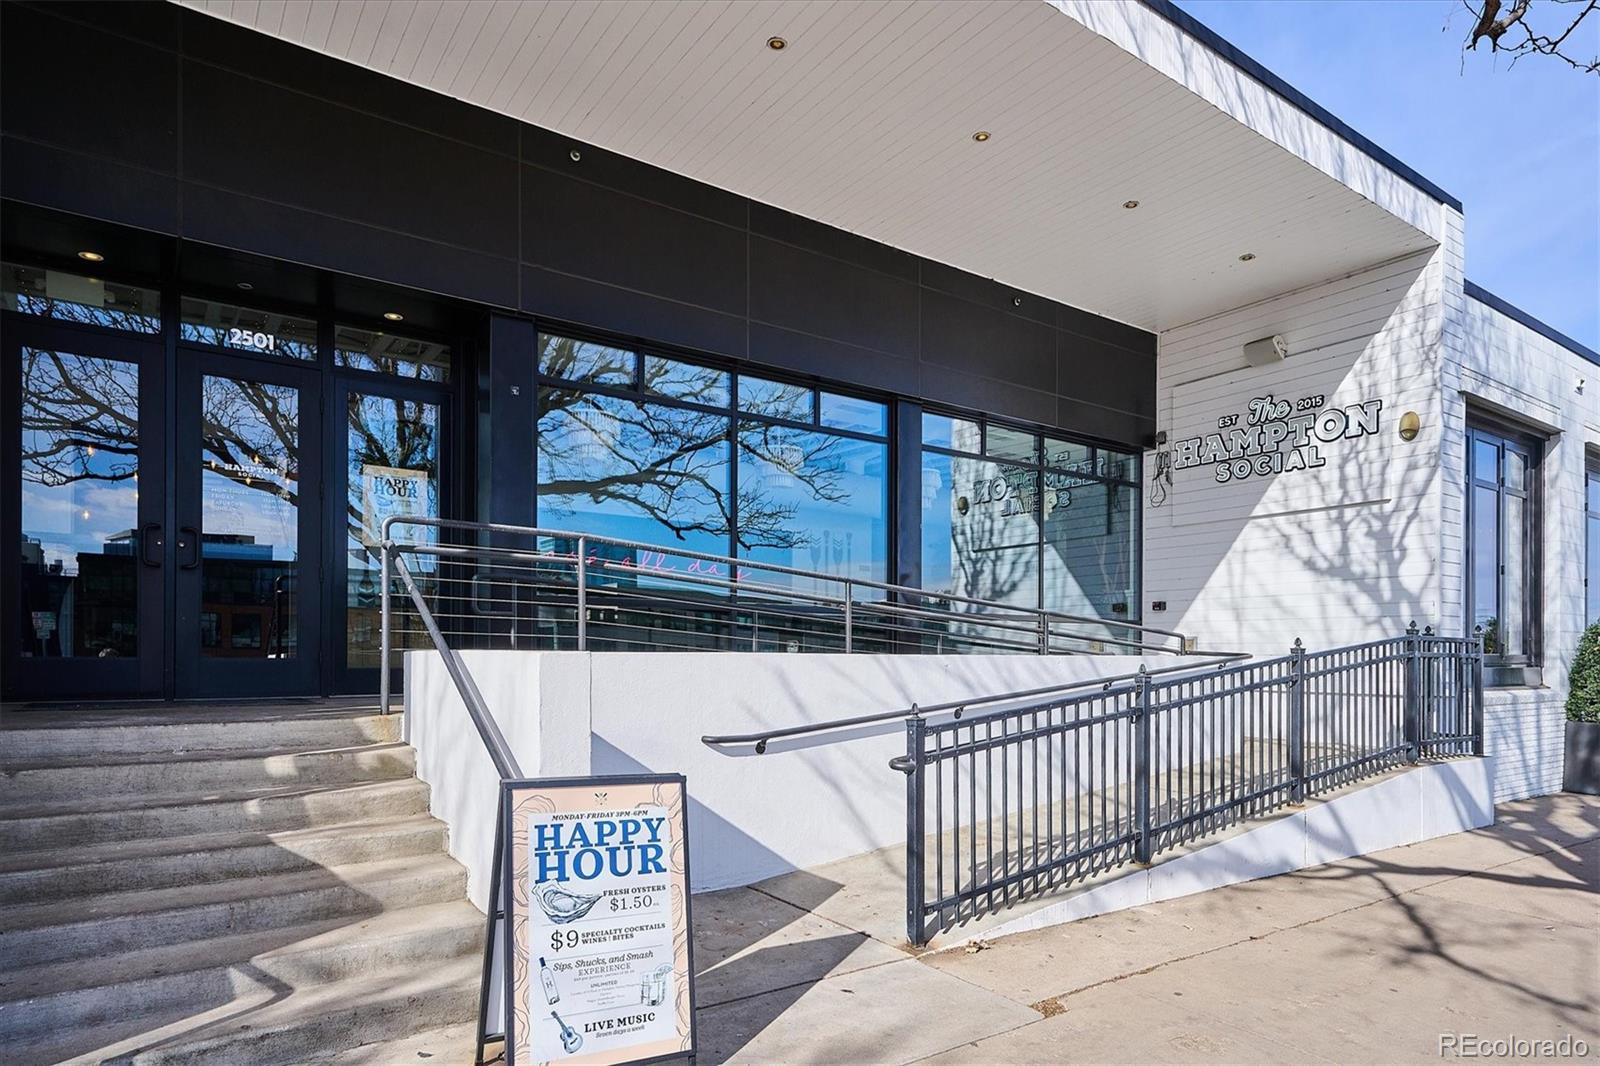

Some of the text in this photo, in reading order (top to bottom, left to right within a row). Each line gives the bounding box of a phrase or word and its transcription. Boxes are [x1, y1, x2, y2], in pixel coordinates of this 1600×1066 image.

[229, 328, 275, 350] 2501
[1218, 394, 1325, 428] EST The 2015
[1174, 399, 1382, 470] HAMPTON
[224, 463, 278, 475] HAMPTON
[1215, 446, 1326, 483] SOCIAL
[374, 476, 418, 488] HAPPY
[374, 484, 418, 498] HOUR
[534, 817, 665, 851] HAPPY
[534, 843, 667, 884] HOUR
[603, 884, 666, 897] FRESH OYSTERS
[610, 894, 652, 912] $1.50
[551, 922, 666, 952] $9 SPECIALTY COCKTAILS
[581, 933, 634, 945] WINES BITES
[553, 962, 573, 973] Sips,
[608, 954, 626, 965] and
[626, 950, 654, 961] Smash
[578, 962, 631, 976] EXPERIENCE
[584, 1012, 656, 1033] LIVE MUSIC
